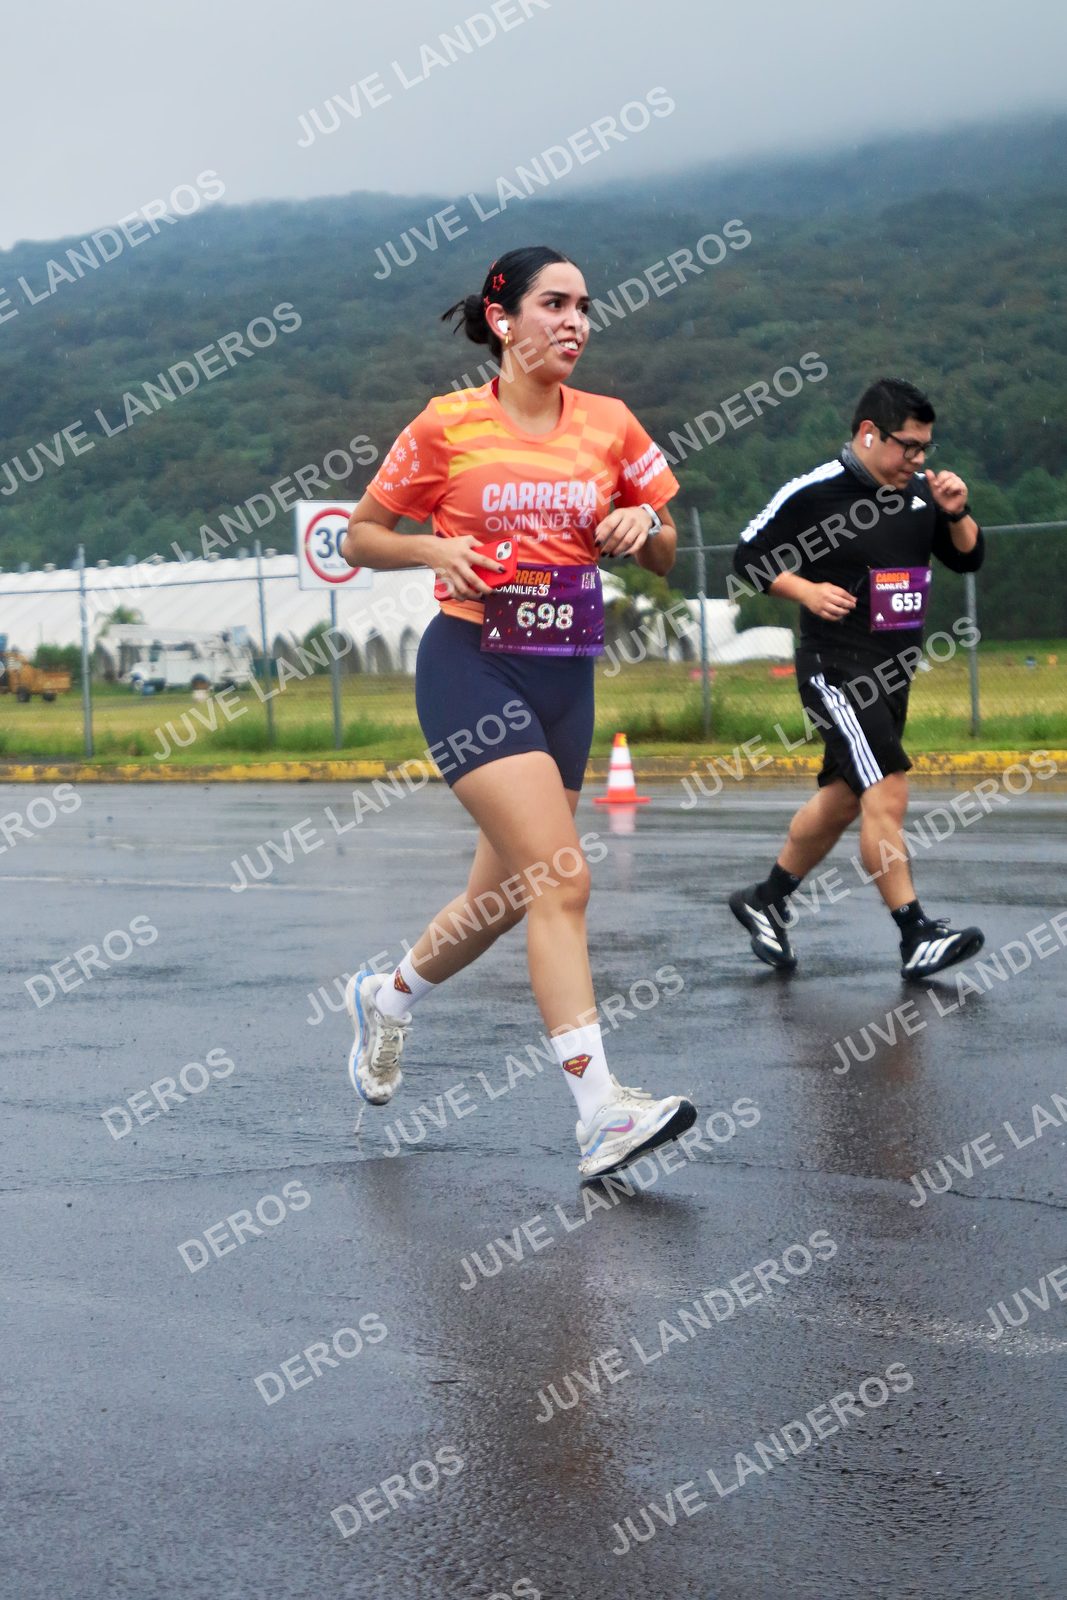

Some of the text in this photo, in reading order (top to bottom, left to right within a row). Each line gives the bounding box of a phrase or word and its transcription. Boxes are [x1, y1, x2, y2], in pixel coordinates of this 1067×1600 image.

[482, 480, 597, 512] CARRERA
[516, 602, 574, 630] 698
[891, 592, 922, 612] 653
